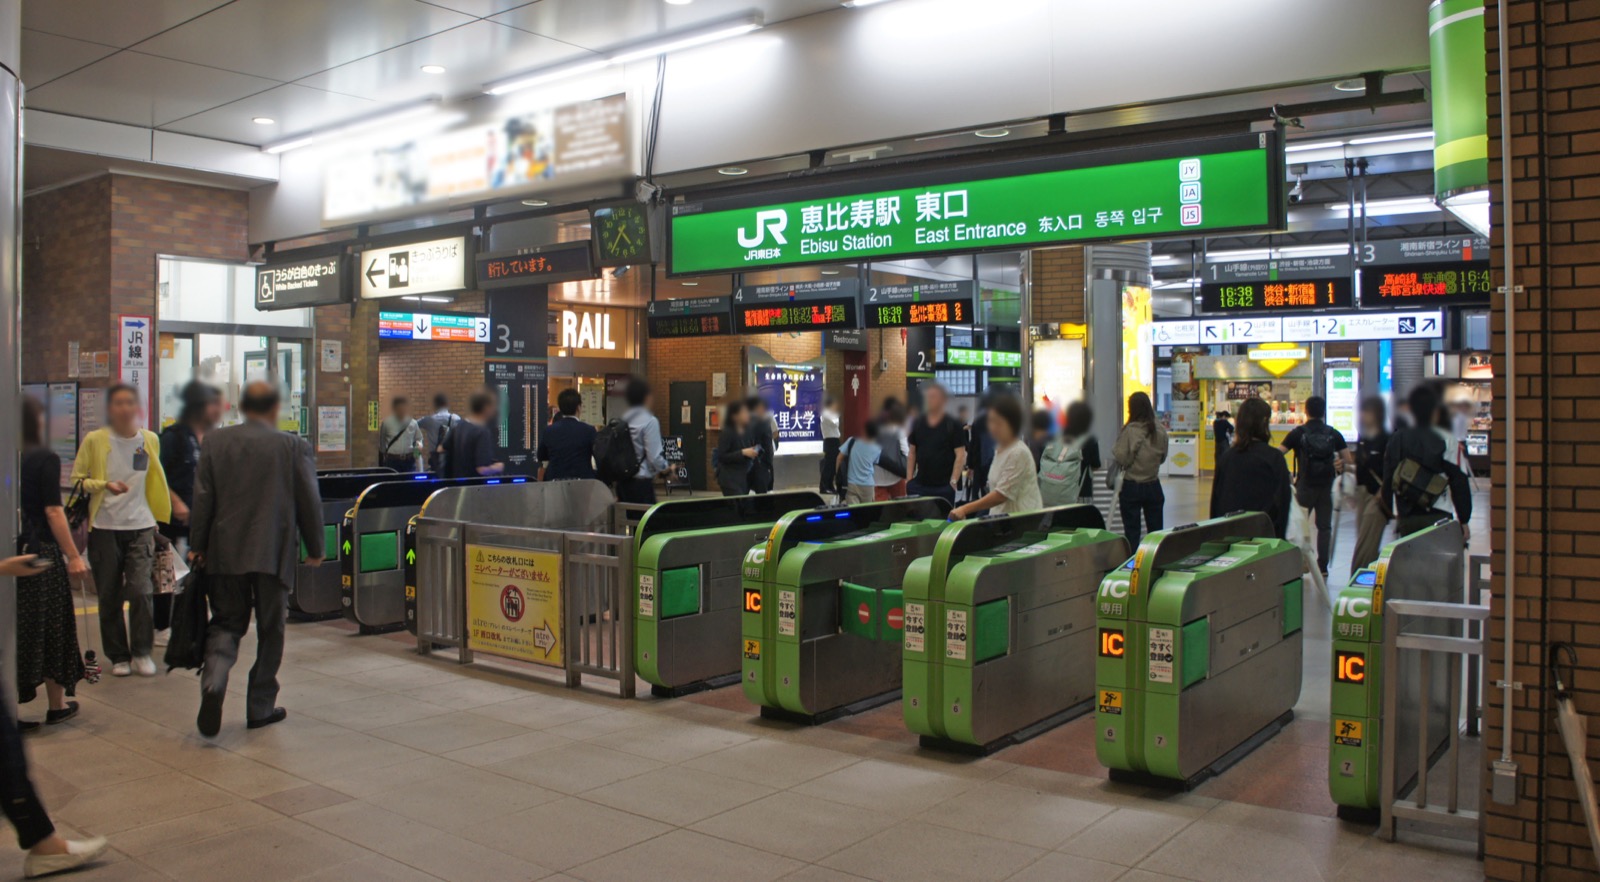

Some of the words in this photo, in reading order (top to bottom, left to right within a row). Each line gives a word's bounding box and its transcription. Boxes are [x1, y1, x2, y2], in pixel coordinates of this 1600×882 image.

[1184, 165, 1196, 175] JY
[1184, 188, 1196, 198] JA
[800, 196, 900, 235] 恵比寿駅
[915, 189, 968, 222] 東口
[1094, 210, 1125, 228] 동쪽
[1132, 207, 1163, 226] 입구
[1185, 210, 1196, 220] JS
[737, 208, 788, 248] JR
[1038, 214, 1082, 234] 东入口
[915, 227, 950, 245] East
[955, 219, 1026, 241] Entrance
[800, 239, 838, 256] Ebisu
[842, 233, 892, 251] Station
[411, 243, 458, 263] きっぷうりば
[744, 247, 781, 262] JR東日本
[1363, 244, 1376, 263] 3
[1400, 240, 1460, 251] 湘南新宿ライン
[275, 261, 336, 282] うらが白色のきっぷ
[1210, 265, 1218, 281] 1
[1384, 272, 1418, 285] 高崎線
[735, 288, 743, 302] 4
[869, 287, 878, 302] 2
[1220, 286, 1253, 298] 16:38
[648, 302, 655, 315] 4
[878, 306, 902, 316] 16:38
[954, 302, 962, 311] 2
[1220, 297, 1253, 308] 16:42
[789, 306, 812, 317] 16:37
[878, 315, 902, 325] 16:41
[955, 311, 962, 321] 2
[790, 314, 814, 325] 16:52
[1348, 317, 1395, 326] エスカレーター
[478, 321, 487, 338] 3
[562, 311, 616, 349] RAIL
[496, 324, 511, 353] 3
[833, 334, 859, 345] Restrooms
[917, 351, 925, 371] 2
[788, 430, 815, 438] UNIVERSITY
[487, 554, 534, 566] こちらの改札口には
[745, 548, 766, 564] IC
[474, 564, 551, 583] エレベーターがございません
[744, 567, 760, 578] 専用
[1101, 579, 1130, 599] IC
[745, 591, 762, 612] IC
[779, 601, 794, 611] 今すぐ
[1337, 596, 1371, 618] IC
[1100, 602, 1123, 615] 専用
[906, 615, 924, 625] 今すぐ
[947, 622, 966, 632] 今すぐ
[1336, 622, 1364, 637] 専用
[536, 631, 550, 641] atre
[1102, 632, 1124, 656] IC
[1150, 642, 1172, 653] 今すぐ
[643, 652, 648, 660] 4
[1150, 652, 1164, 662] 登録
[1338, 655, 1364, 681] IC
[749, 671, 754, 679] 4
[912, 698, 917, 706] 5
[953, 705, 958, 713] 6
[1107, 729, 1113, 737] 6
[1157, 736, 1163, 745] 7
[1344, 762, 1351, 771] 7
